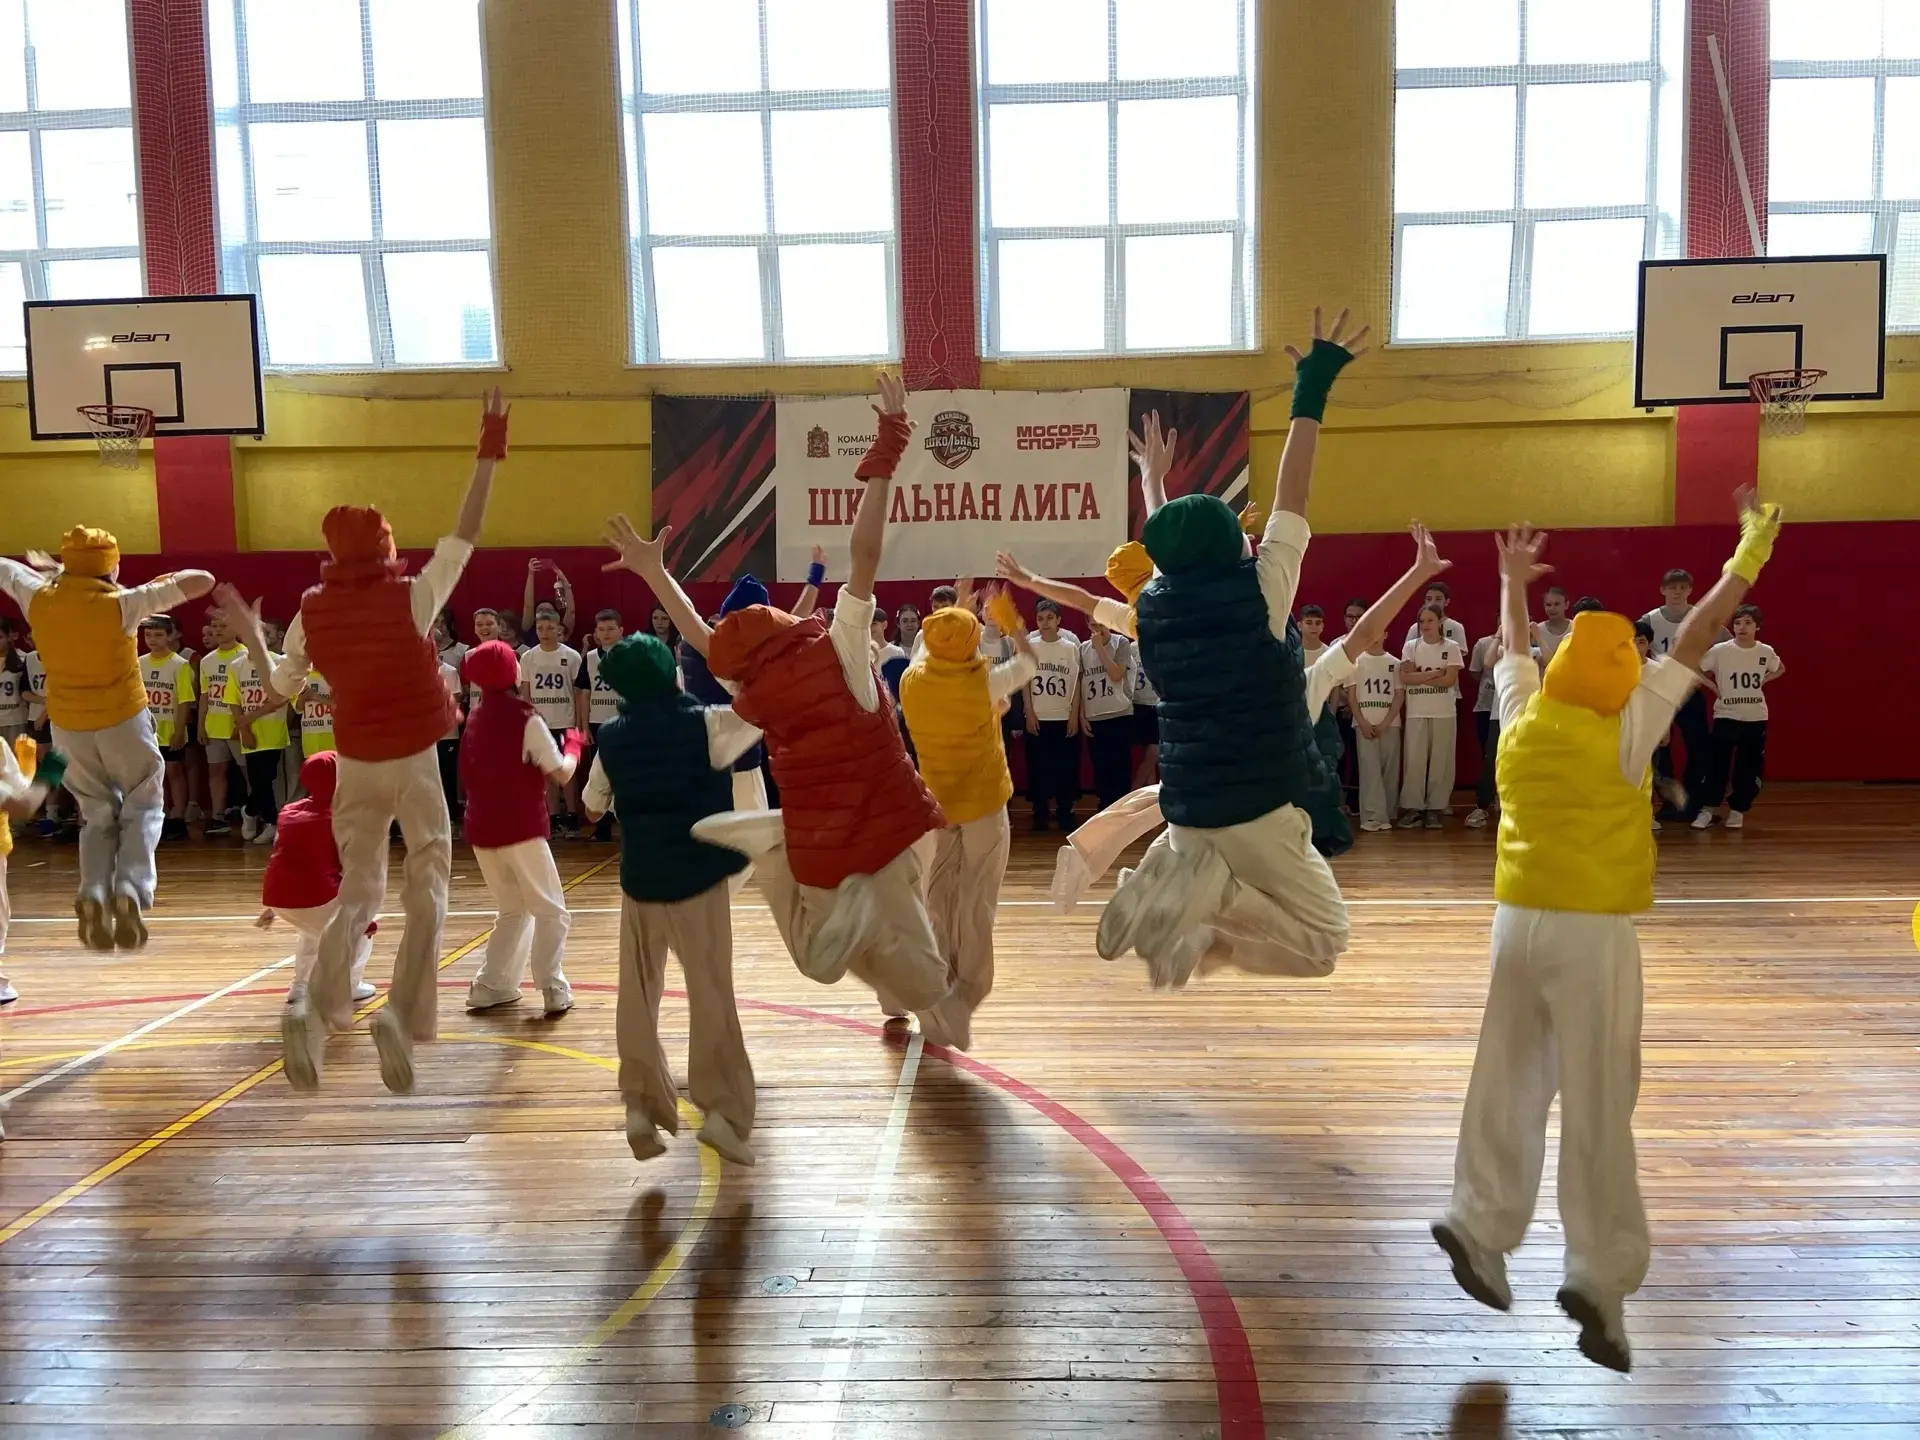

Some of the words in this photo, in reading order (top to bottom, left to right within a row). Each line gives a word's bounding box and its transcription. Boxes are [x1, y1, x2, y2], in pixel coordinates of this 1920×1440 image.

[1732, 292, 1795, 304] elan
[112, 332, 171, 343] elan
[1017, 424, 1098, 437] МОСОБЛ
[837, 448, 868, 456] ГУБЕР
[1017, 438, 1081, 450] СПОРТ
[808, 482, 1001, 525] ШКЛЬНАЯ
[1010, 482, 1101, 521] ЛИГА
[535, 673, 564, 689] 249
[1032, 676, 1067, 697] 363
[1364, 678, 1391, 695] 112
[1730, 672, 1761, 689] 103
[1087, 678, 1114, 700] 318
